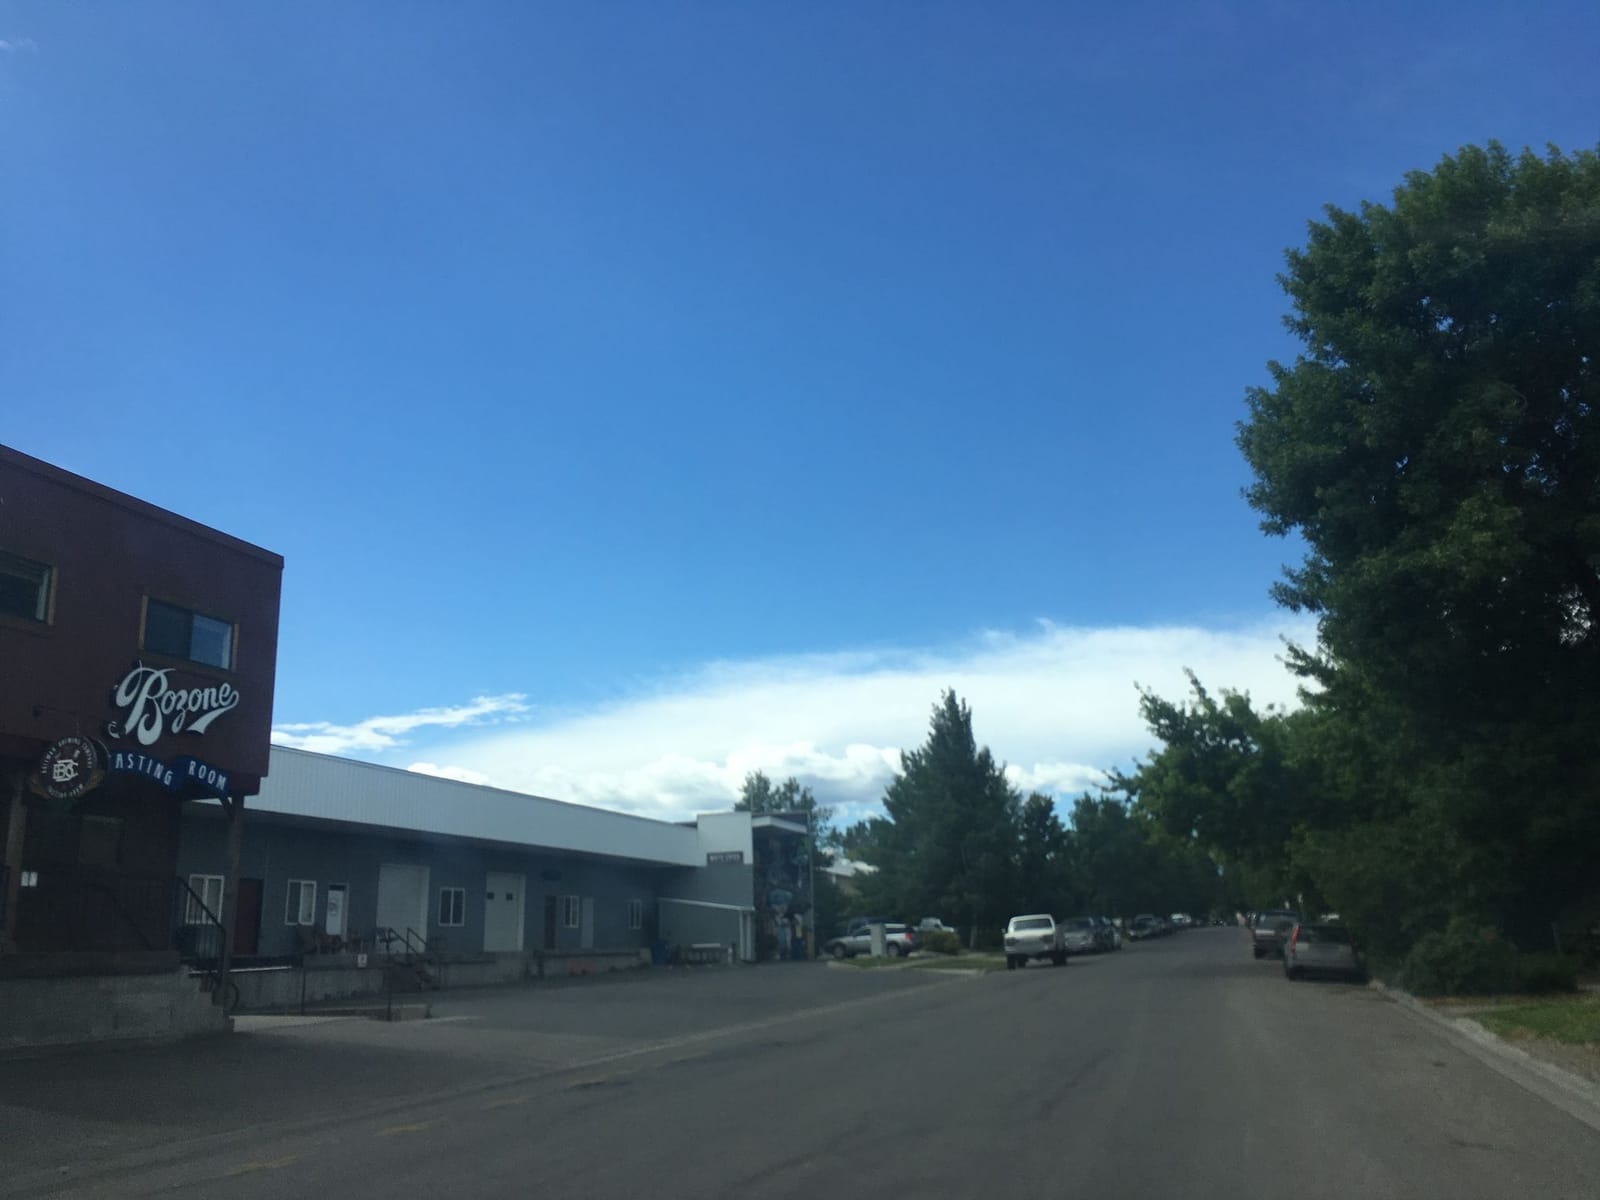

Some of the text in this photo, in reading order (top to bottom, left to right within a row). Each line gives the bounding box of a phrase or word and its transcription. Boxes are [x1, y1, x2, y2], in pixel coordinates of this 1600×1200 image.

[114, 659, 240, 746] Bozone
[115, 752, 227, 790] ASTING ROOM
